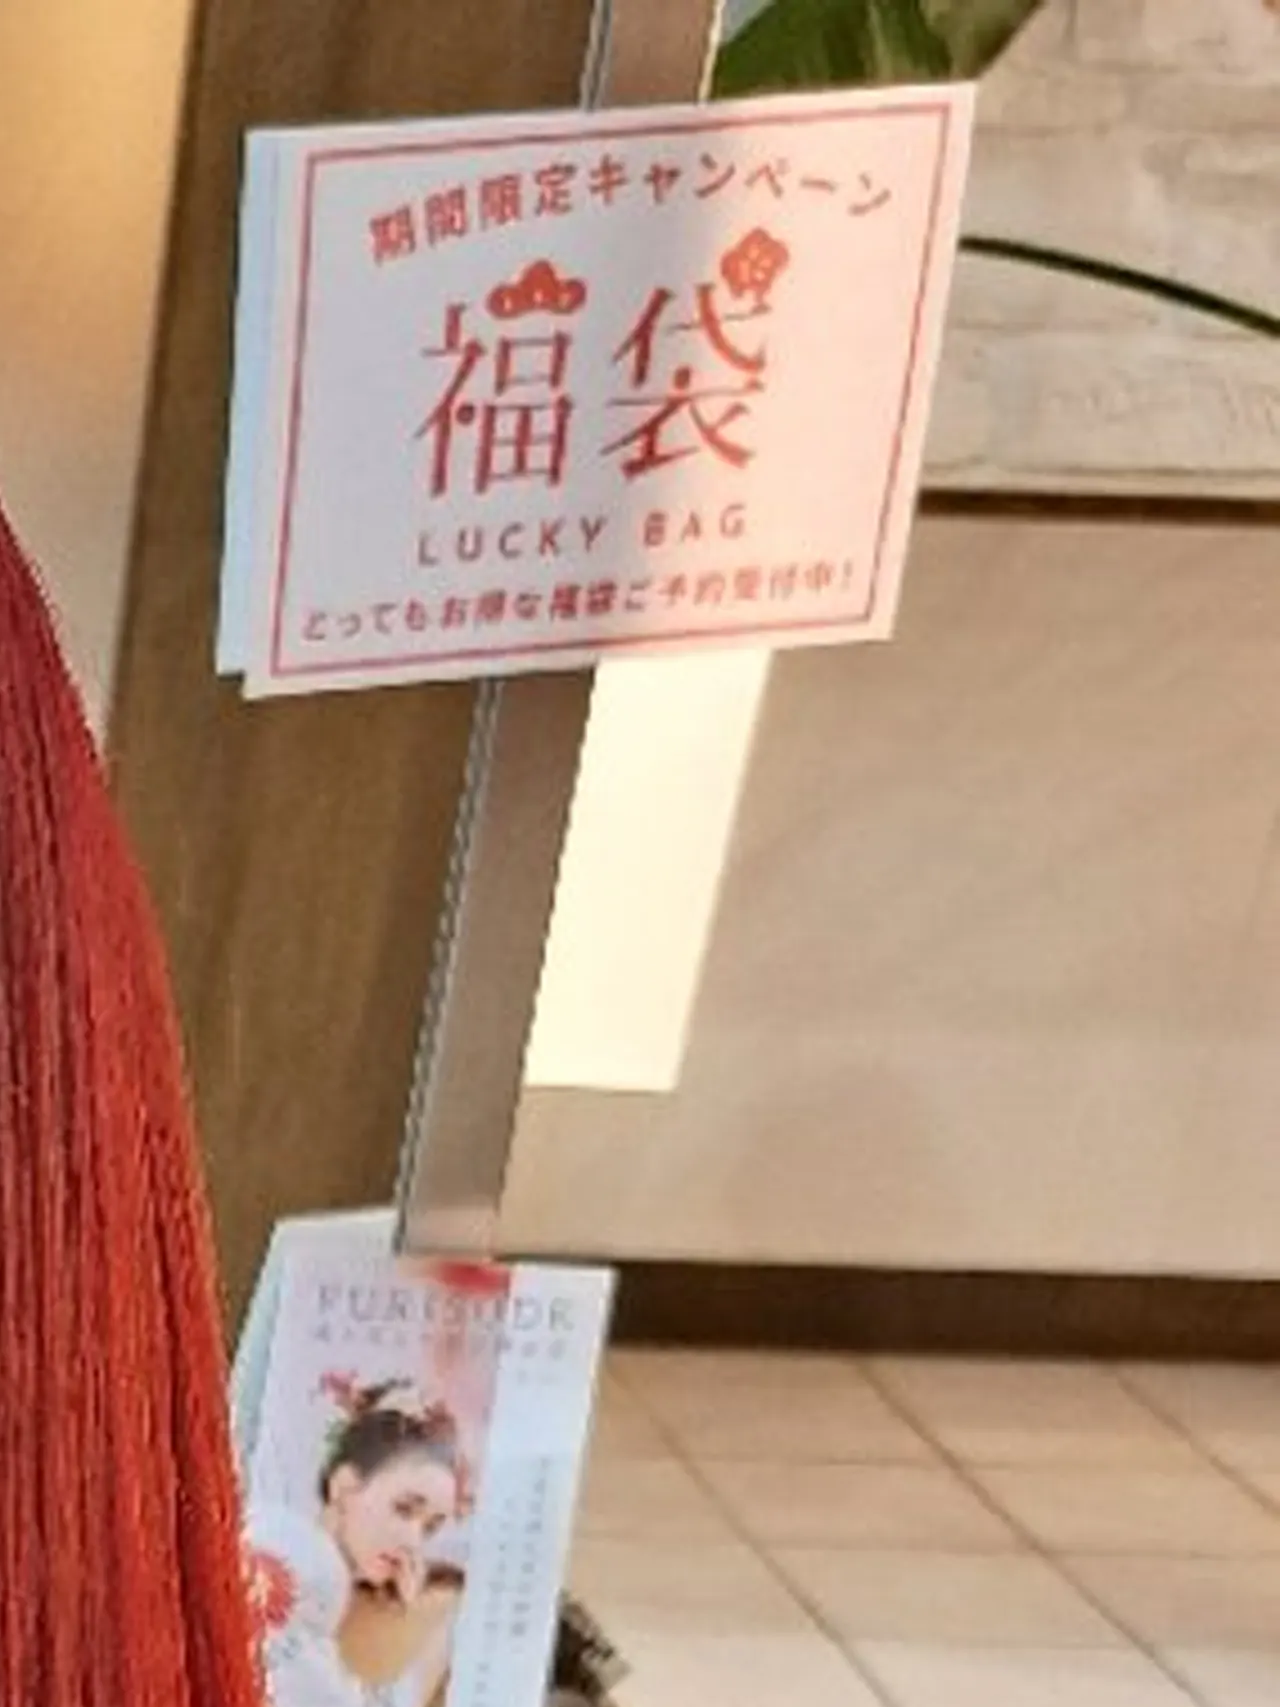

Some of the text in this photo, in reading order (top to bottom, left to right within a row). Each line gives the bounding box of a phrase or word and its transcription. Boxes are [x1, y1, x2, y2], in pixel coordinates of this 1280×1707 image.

[367, 153, 892, 264] 期間限定キャンペーン
[414, 282, 772, 498] 福袋
[417, 503, 746, 566] LUCKY BAG
